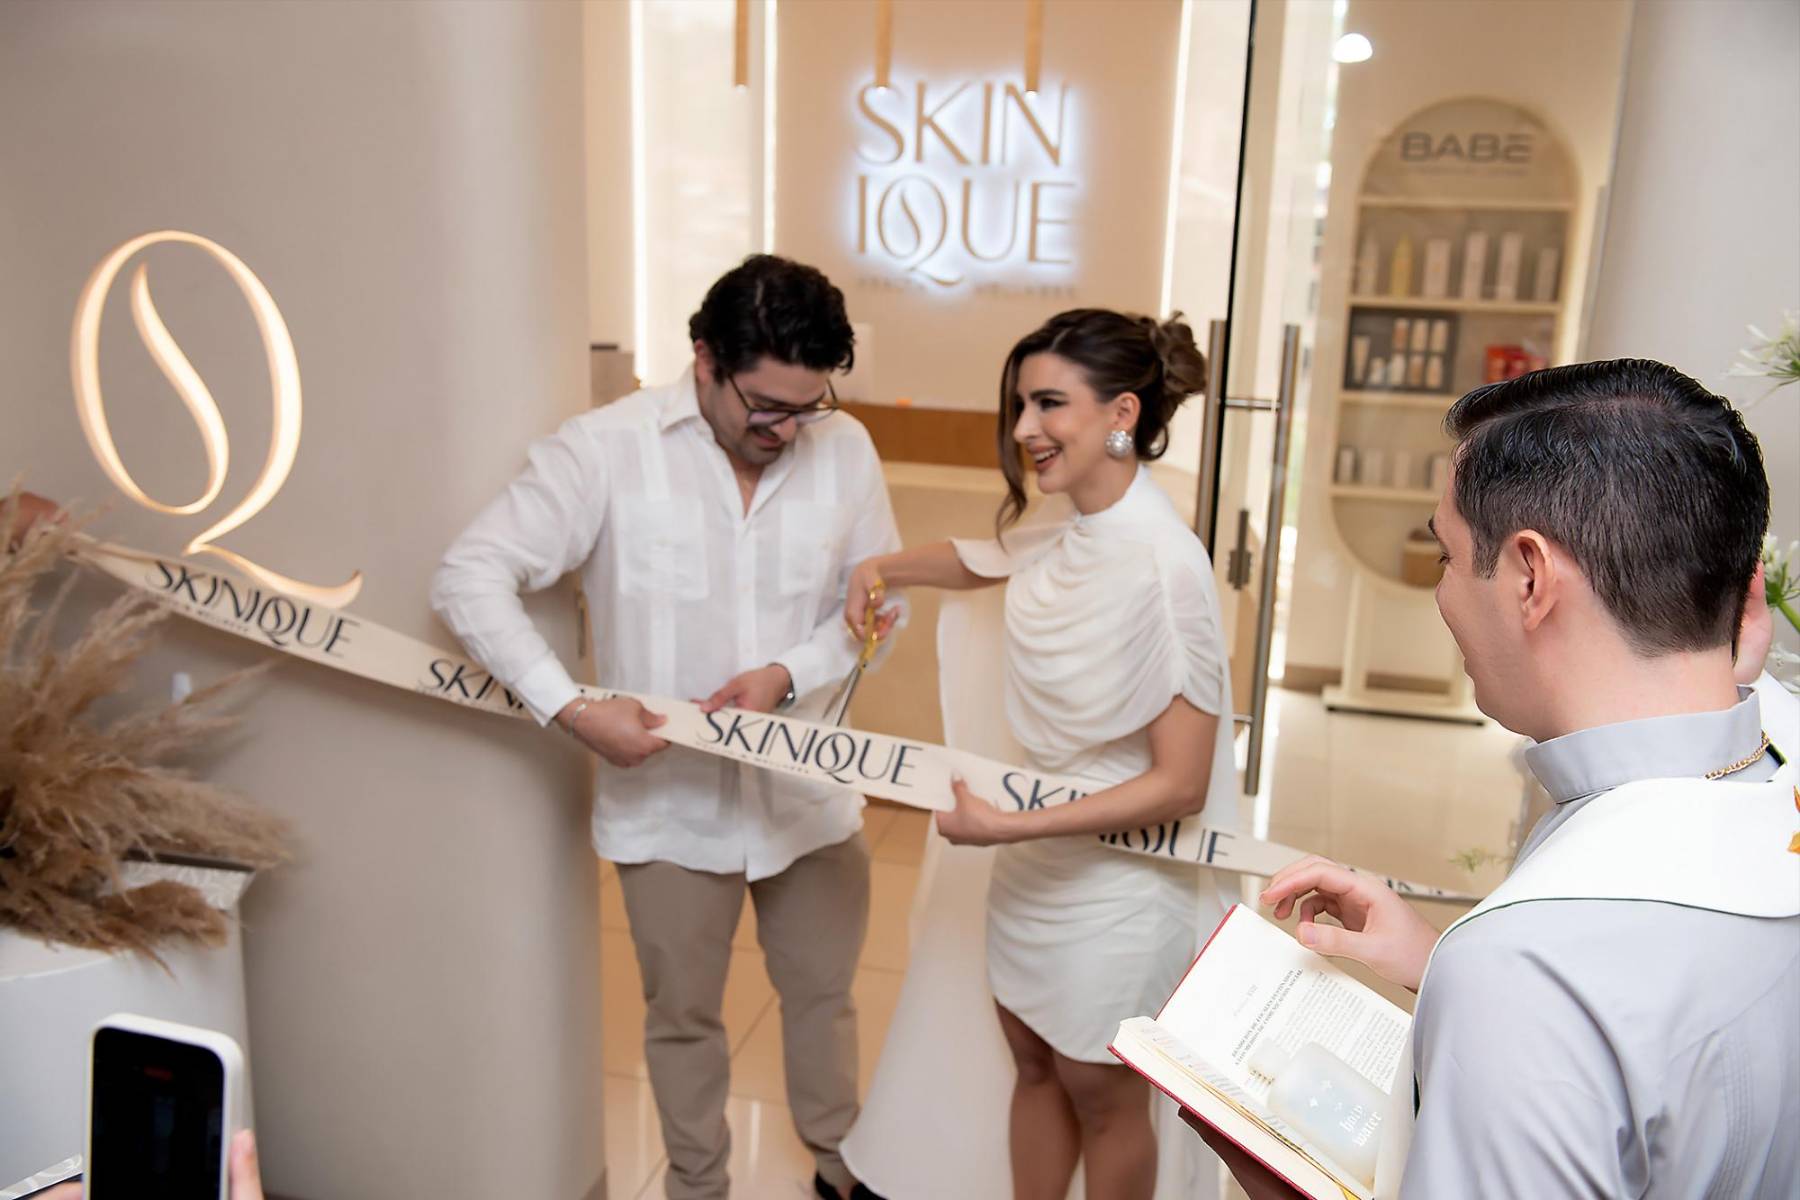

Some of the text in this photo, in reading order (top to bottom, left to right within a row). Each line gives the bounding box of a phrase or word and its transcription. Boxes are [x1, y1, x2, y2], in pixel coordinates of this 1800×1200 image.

[857, 80, 1070, 167] SKIN
[858, 174, 1075, 286] IQUE
[70, 230, 363, 609] Q
[145, 560, 361, 660] SKINIQUE
[696, 709, 924, 788] SKINIQUE
[1352, 1111, 1382, 1147] water
